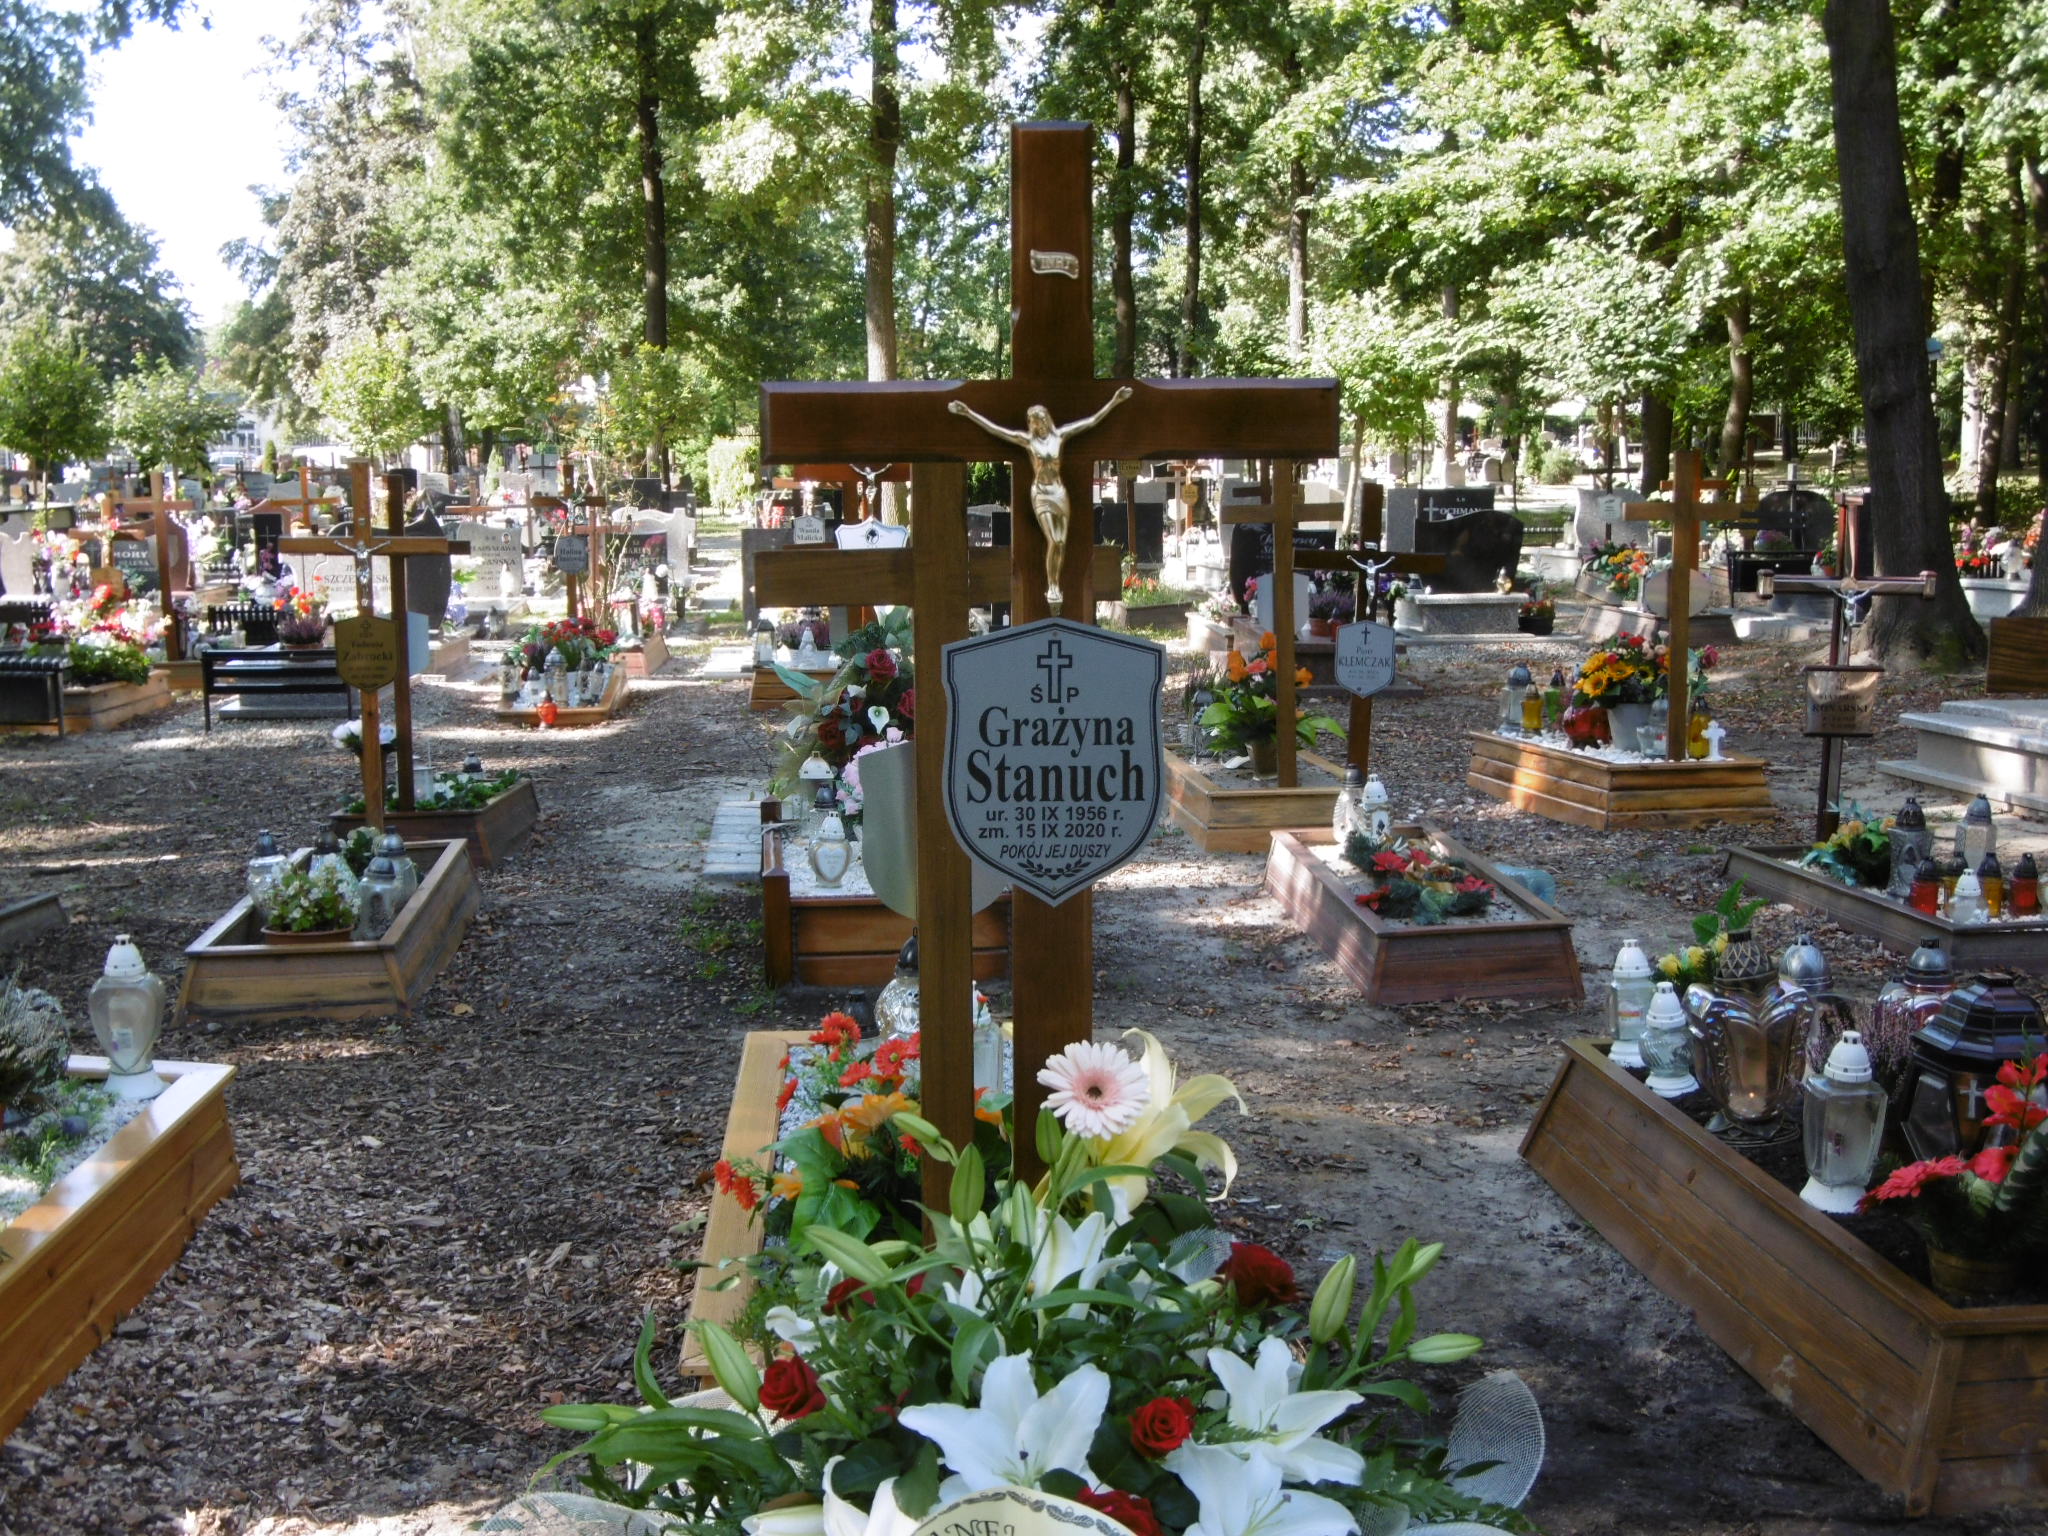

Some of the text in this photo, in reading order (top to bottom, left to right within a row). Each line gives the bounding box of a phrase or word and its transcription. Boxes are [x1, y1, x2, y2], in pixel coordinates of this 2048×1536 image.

[1338, 655, 1392, 668] KLEMCZAK
[1030, 684, 1080, 704] Ś P
[978, 705, 1136, 758] Grażyna
[966, 749, 1146, 803] Stanuch
[985, 806, 1125, 822] ur. 30 IX 1956 r.
[977, 822, 1123, 840] zm. 15 IX 2020 r.
[999, 840, 1113, 860] POKÓJ JEJ DUSZY
